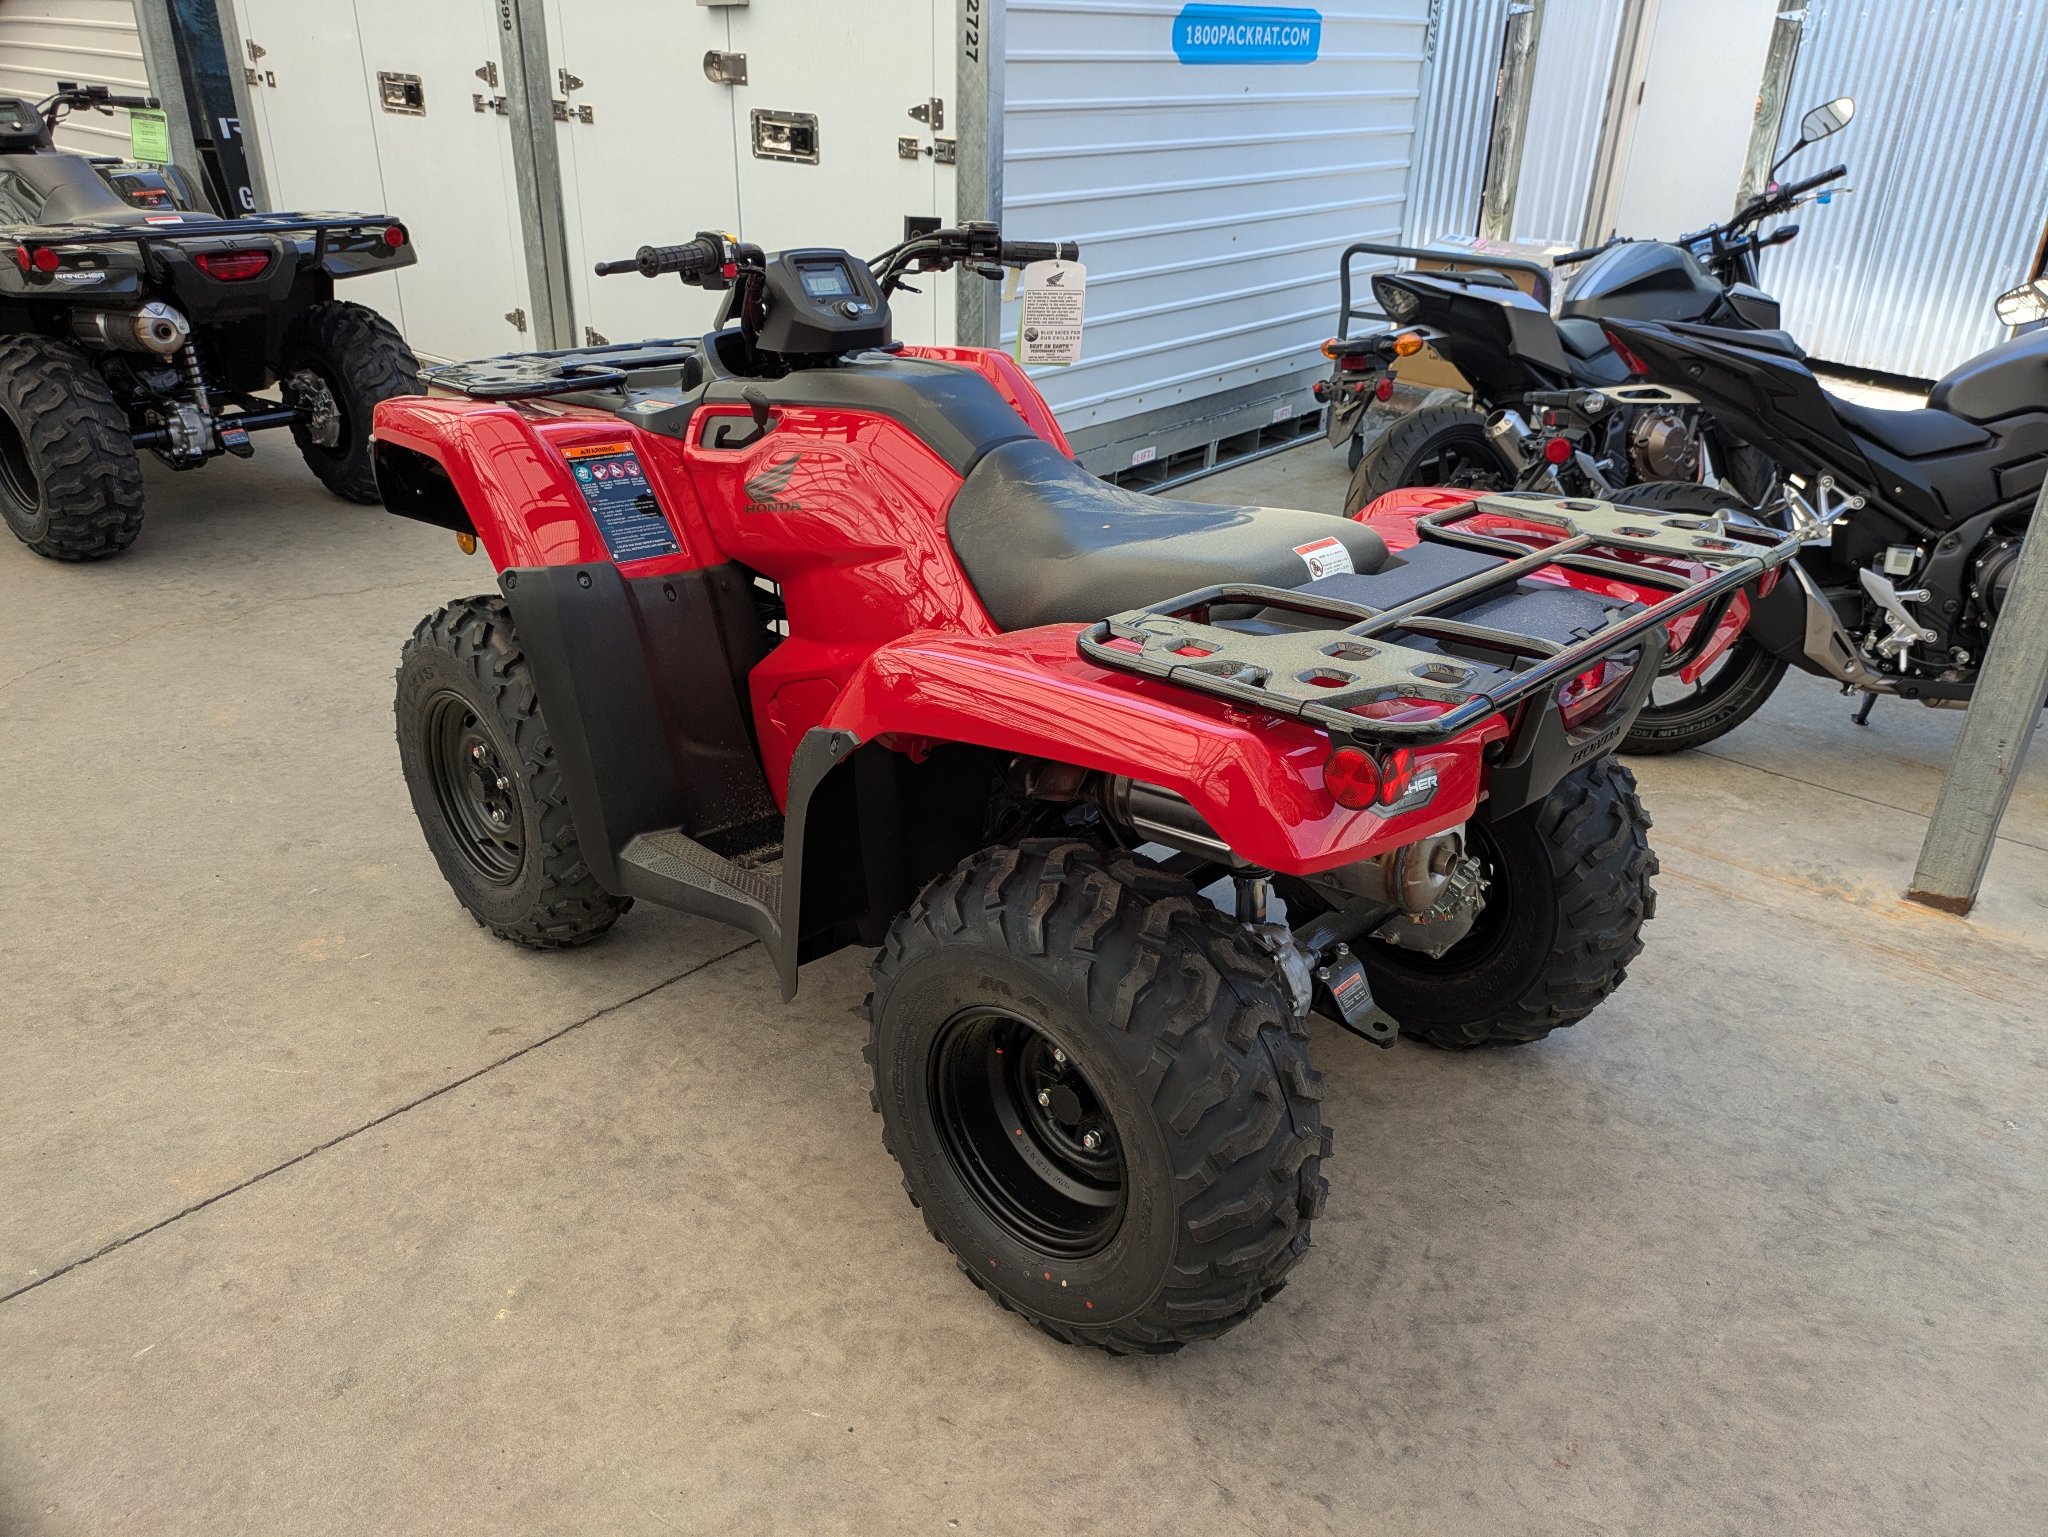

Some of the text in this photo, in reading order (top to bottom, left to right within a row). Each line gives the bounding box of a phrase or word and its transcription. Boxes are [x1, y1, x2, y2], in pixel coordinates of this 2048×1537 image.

[1186, 25, 1311, 46] 1800PACKRAT.COM
[55, 271, 106, 280] RANCHER
[585, 445, 615, 454] WARNING
[1136, 450, 1152, 463] LIFT
[745, 503, 801, 513] HONDA
[1658, 715, 1717, 737] MICHELIN
[1570, 726, 1620, 764] HONDA
